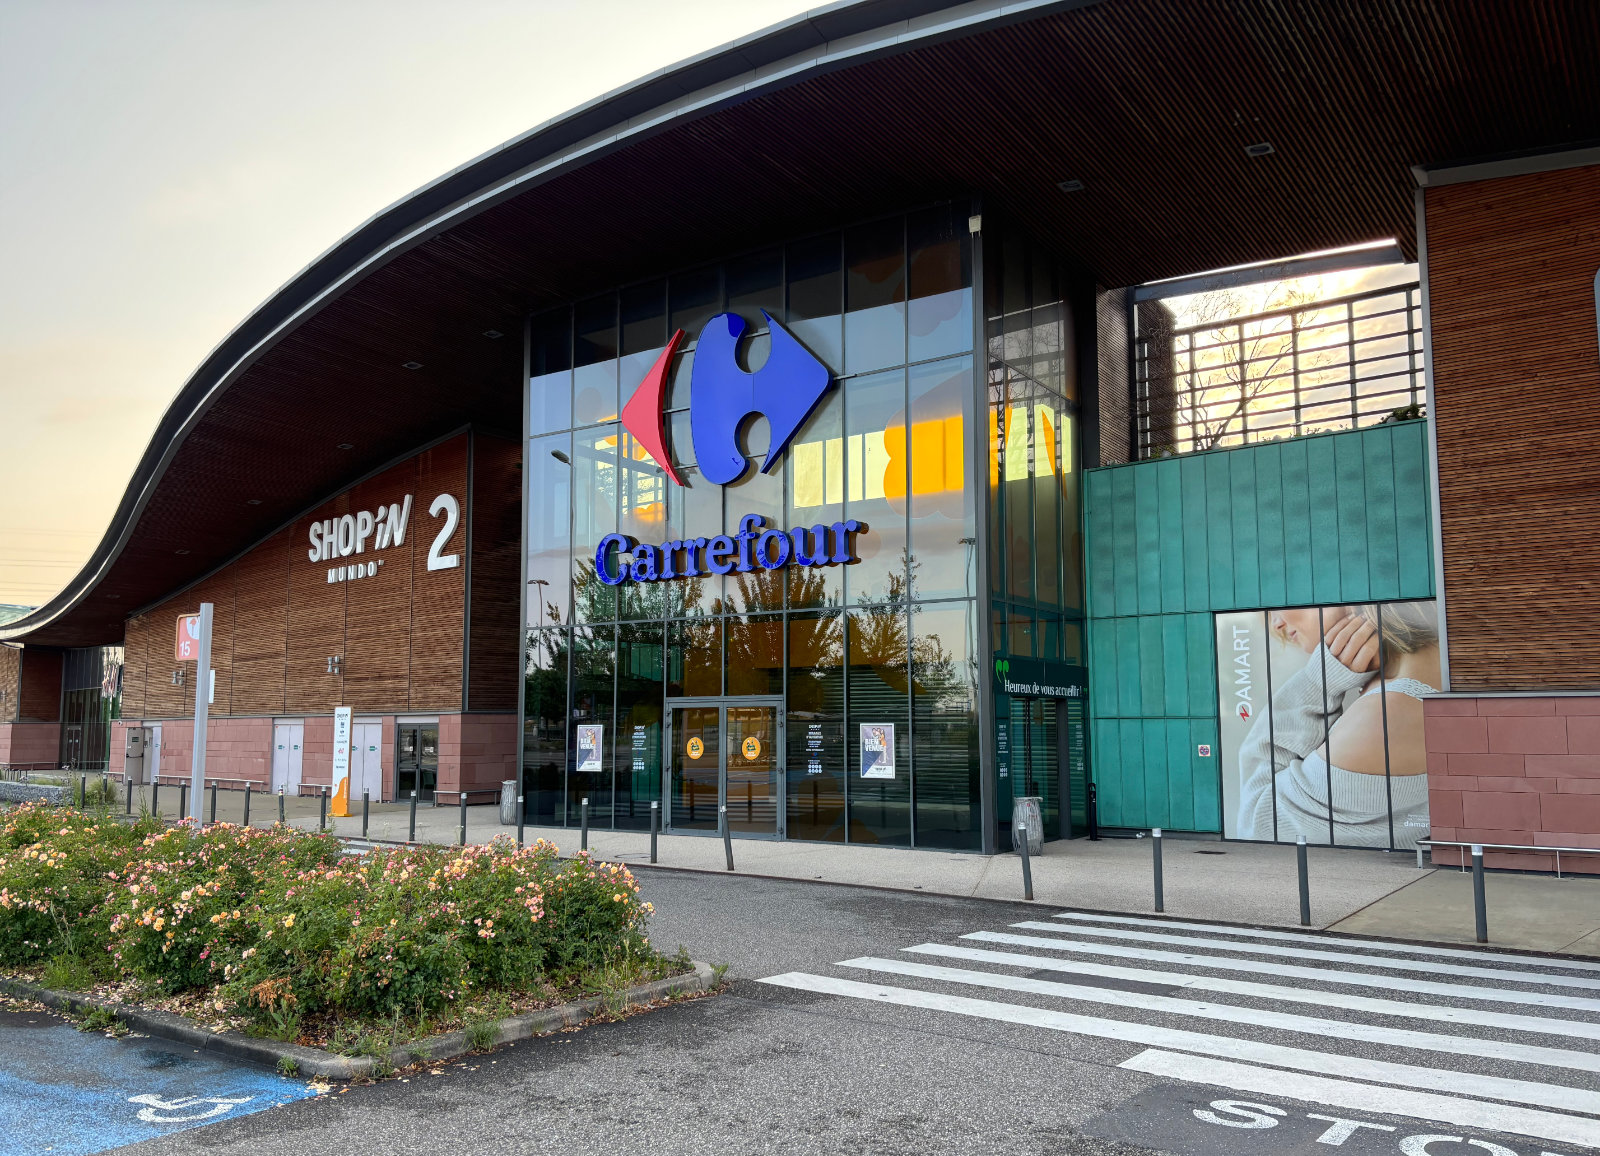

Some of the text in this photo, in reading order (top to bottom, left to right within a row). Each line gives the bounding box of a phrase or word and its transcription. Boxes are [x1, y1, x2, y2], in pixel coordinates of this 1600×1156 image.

[427, 493, 460, 571] 2
[595, 513, 864, 586] Carrefour
[180, 641, 191, 657] 15
[1232, 625, 1252, 722] DAMART
[1004, 680, 1032, 694] Heureux
[1032, 682, 1040, 695] de
[1041, 684, 1055, 696] vous
[864, 744, 884, 752] VENUE
[1192, 1099, 1567, 1156] STO
